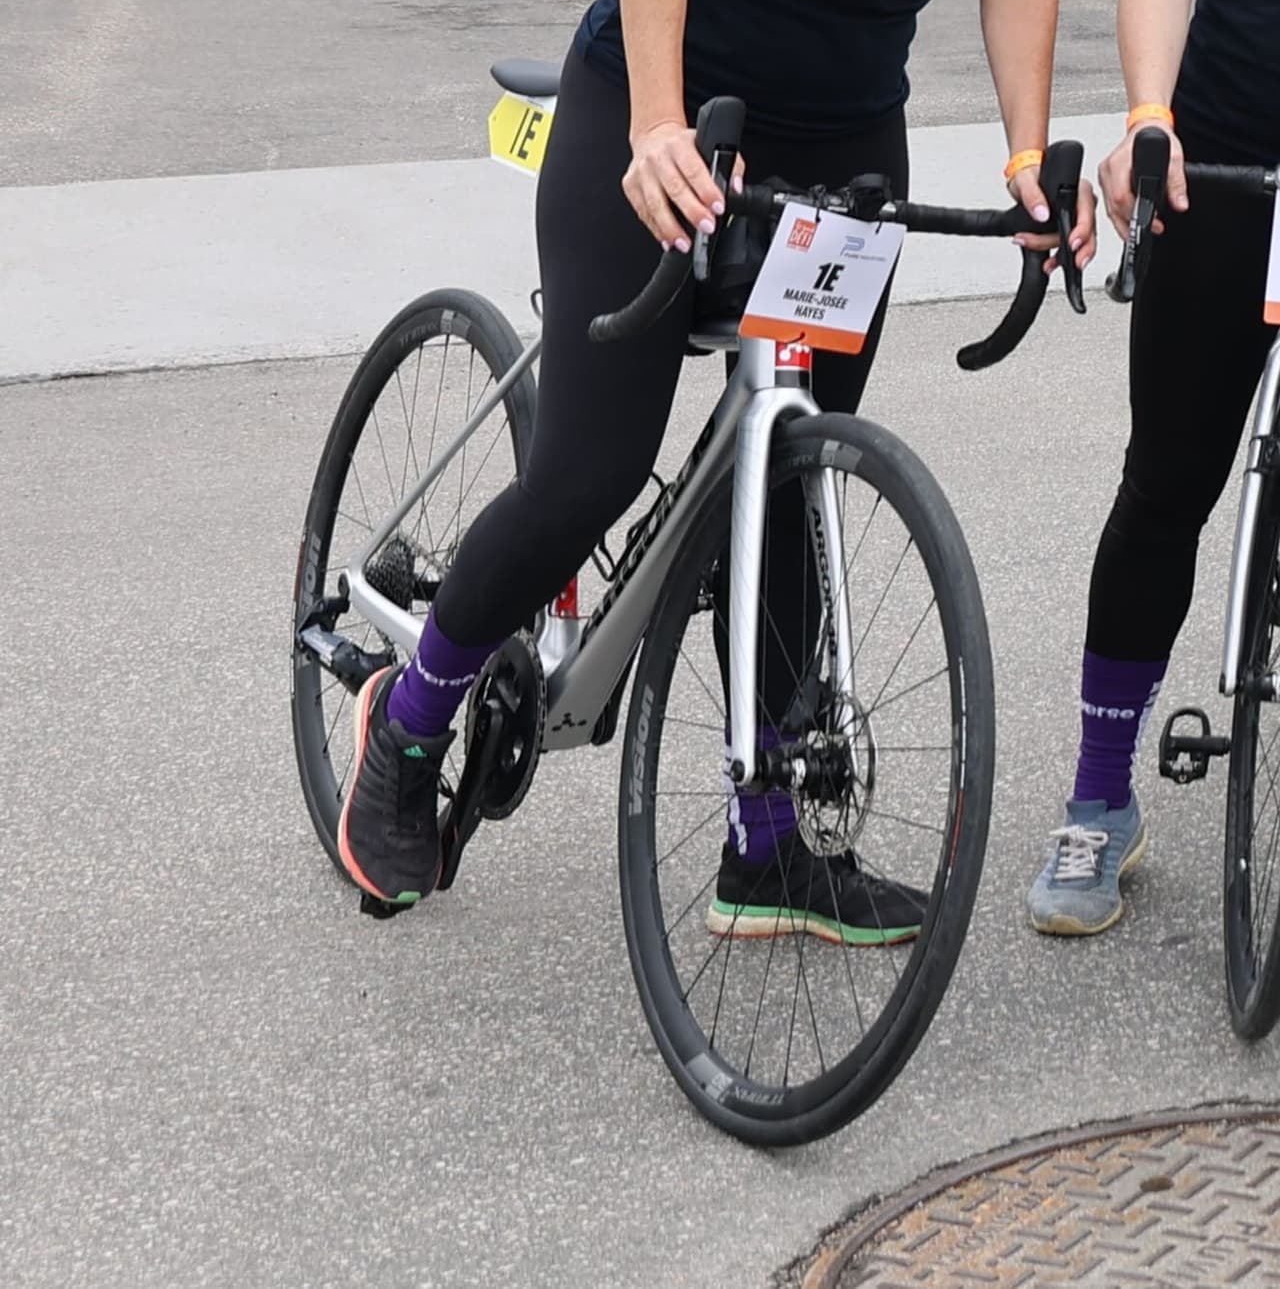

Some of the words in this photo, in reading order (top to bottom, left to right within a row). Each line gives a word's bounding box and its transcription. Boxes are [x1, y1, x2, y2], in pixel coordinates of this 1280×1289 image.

[813, 261, 846, 292] 1E
[782, 288, 849, 311] MARIE-JOSÉE
[793, 305, 826, 321] HAYES
